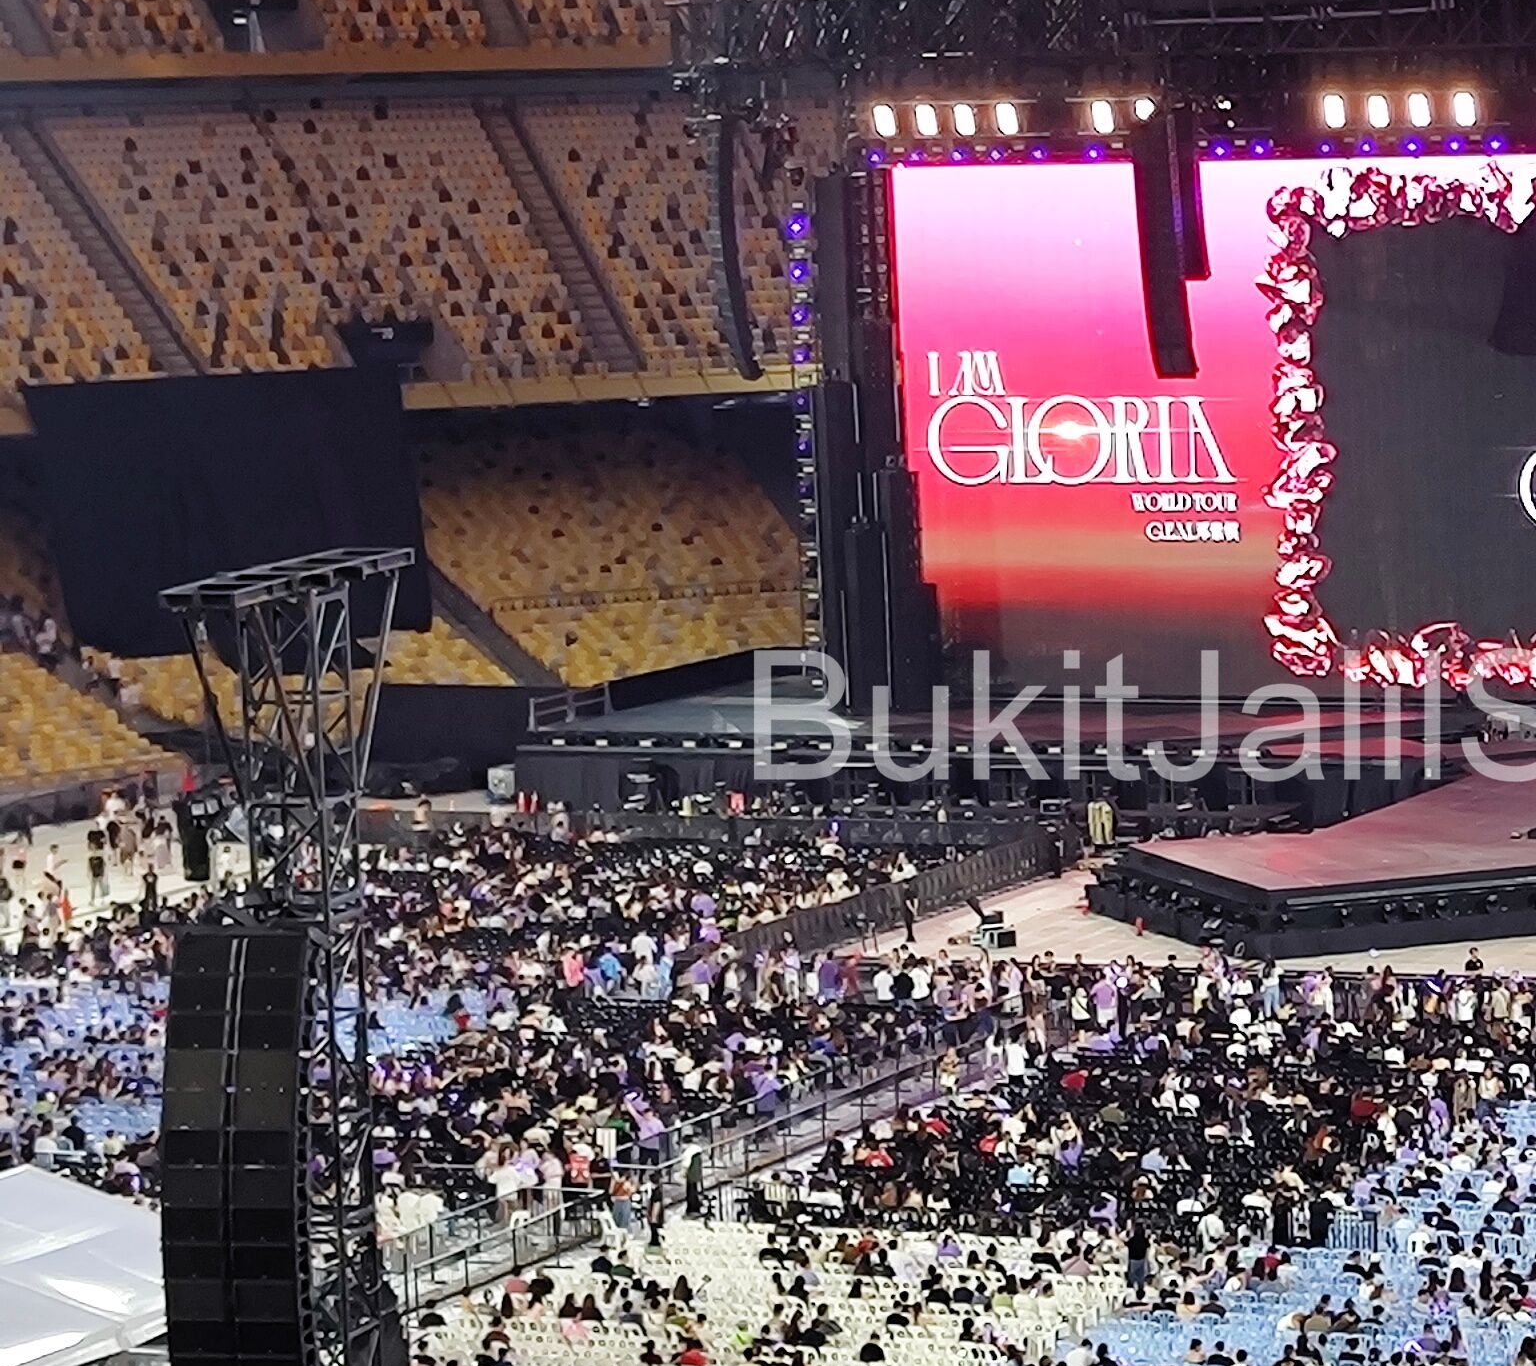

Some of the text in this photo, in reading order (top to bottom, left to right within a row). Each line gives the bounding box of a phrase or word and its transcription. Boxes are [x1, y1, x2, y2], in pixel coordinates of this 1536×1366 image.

[926, 350, 1006, 397] I AM
[927, 395, 1238, 485] GLORIA
[1131, 492, 1191, 512] WORLD
